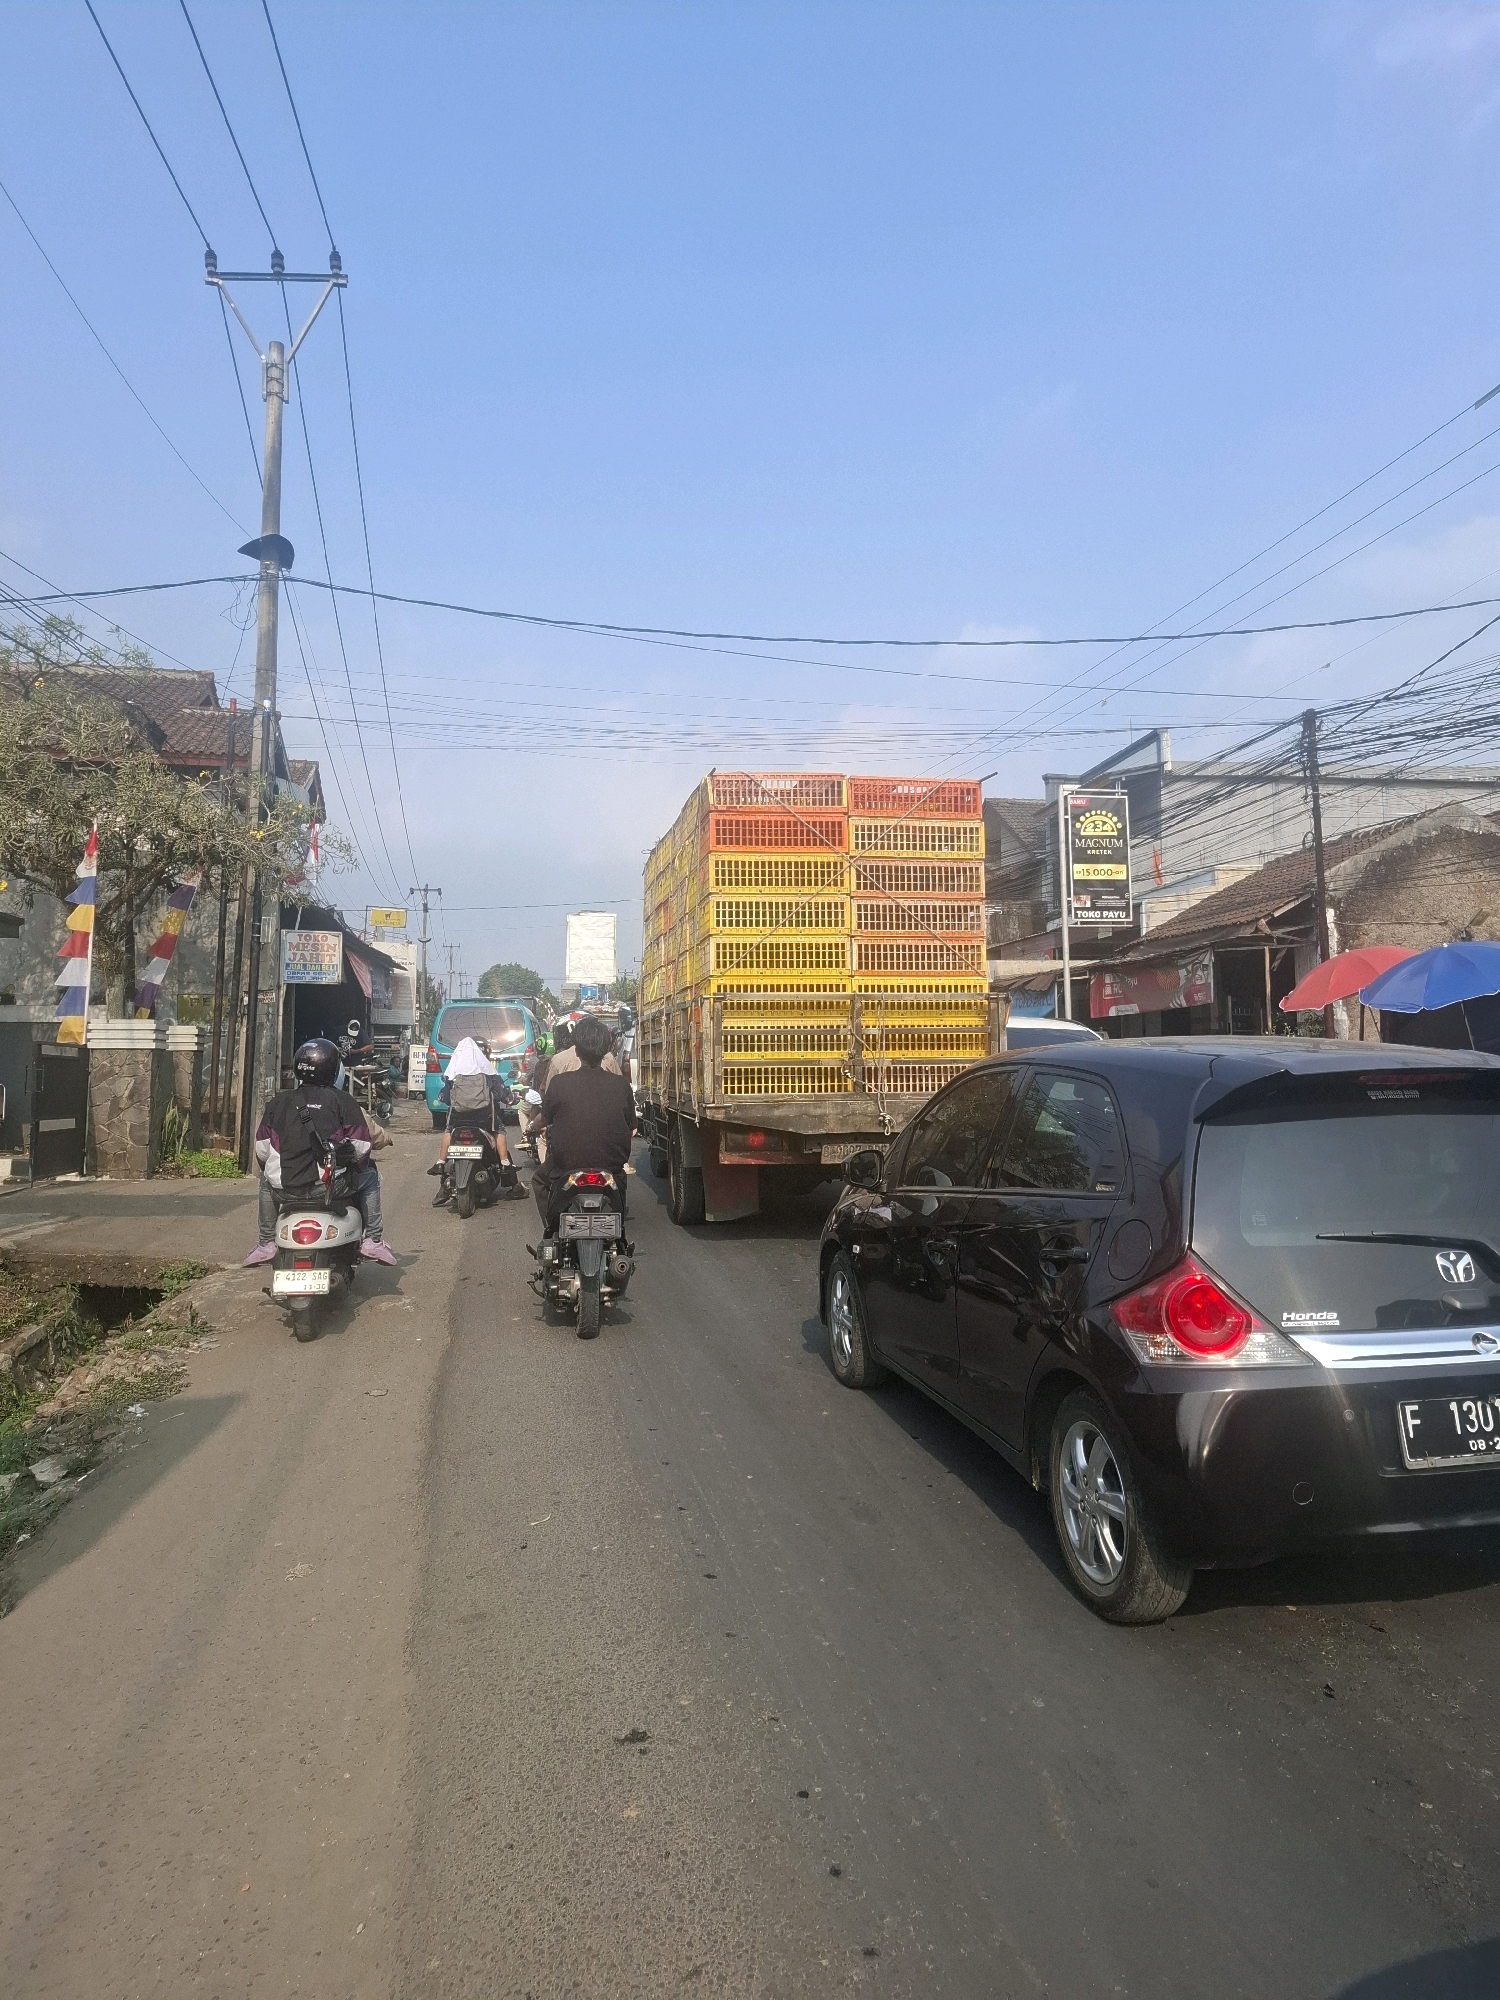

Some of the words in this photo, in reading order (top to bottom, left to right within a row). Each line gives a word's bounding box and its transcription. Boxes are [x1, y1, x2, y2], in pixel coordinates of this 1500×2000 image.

[1085, 820, 1112, 832] 234
[1075, 838, 1123, 848] MAGNUM
[1076, 910, 1101, 918] TOKO
[1102, 910, 1126, 918] PAYU
[297, 933, 329, 943] TOKO
[287, 941, 337, 953] MESIN
[288, 952, 336, 963] JAHIT
[275, 1273, 280, 1281] F
[285, 1272, 307, 1281] 4122
[1282, 1311, 1338, 1321] Honda
[1405, 1405, 1421, 1438] F
